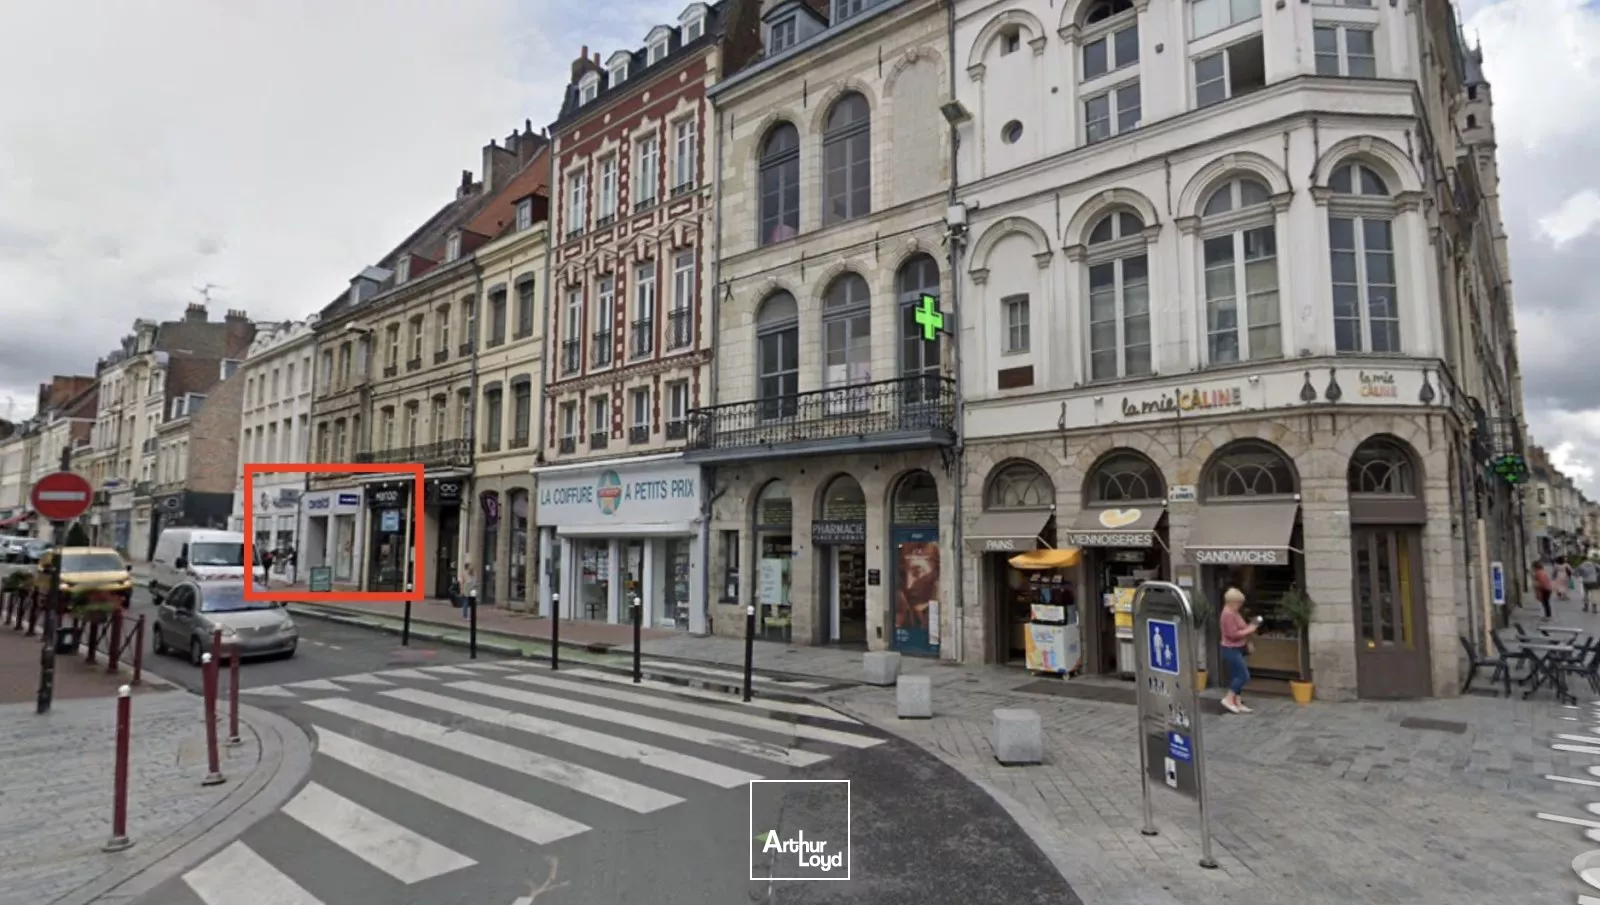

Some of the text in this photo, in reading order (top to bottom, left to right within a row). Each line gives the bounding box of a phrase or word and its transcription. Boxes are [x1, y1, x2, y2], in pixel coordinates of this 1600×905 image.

[1122, 397, 1140, 416] la
[1141, 393, 1175, 413] mie
[540, 488, 551, 505] LA
[554, 486, 593, 504] COIFFURE
[625, 484, 632, 500] A
[634, 480, 668, 500] PETITS
[671, 478, 695, 498] PRIX
[812, 523, 865, 534] PHARMACIE
[986, 539, 1014, 550] PAINS
[1069, 534, 1152, 545] VIENNOISERIES
[1196, 550, 1276, 564] SANDWICHS
